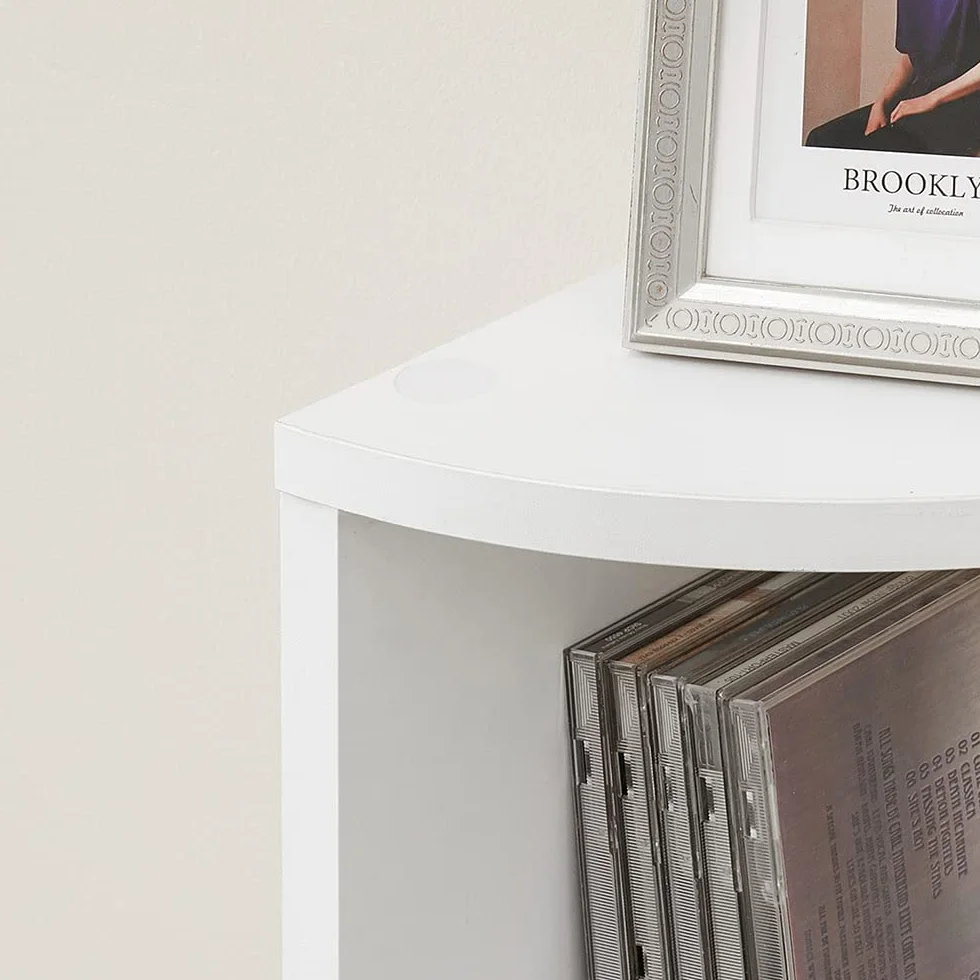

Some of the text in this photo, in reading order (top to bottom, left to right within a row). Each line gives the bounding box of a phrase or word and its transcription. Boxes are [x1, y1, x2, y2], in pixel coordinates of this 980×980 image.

[887, 204, 902, 213] The
[903, 206, 915, 214] art
[916, 206, 925, 215] of
[957, 739, 968, 757] 02
[970, 731, 980, 748] 01
[919, 762, 929, 781] 05
[927, 837, 939, 861] THE
